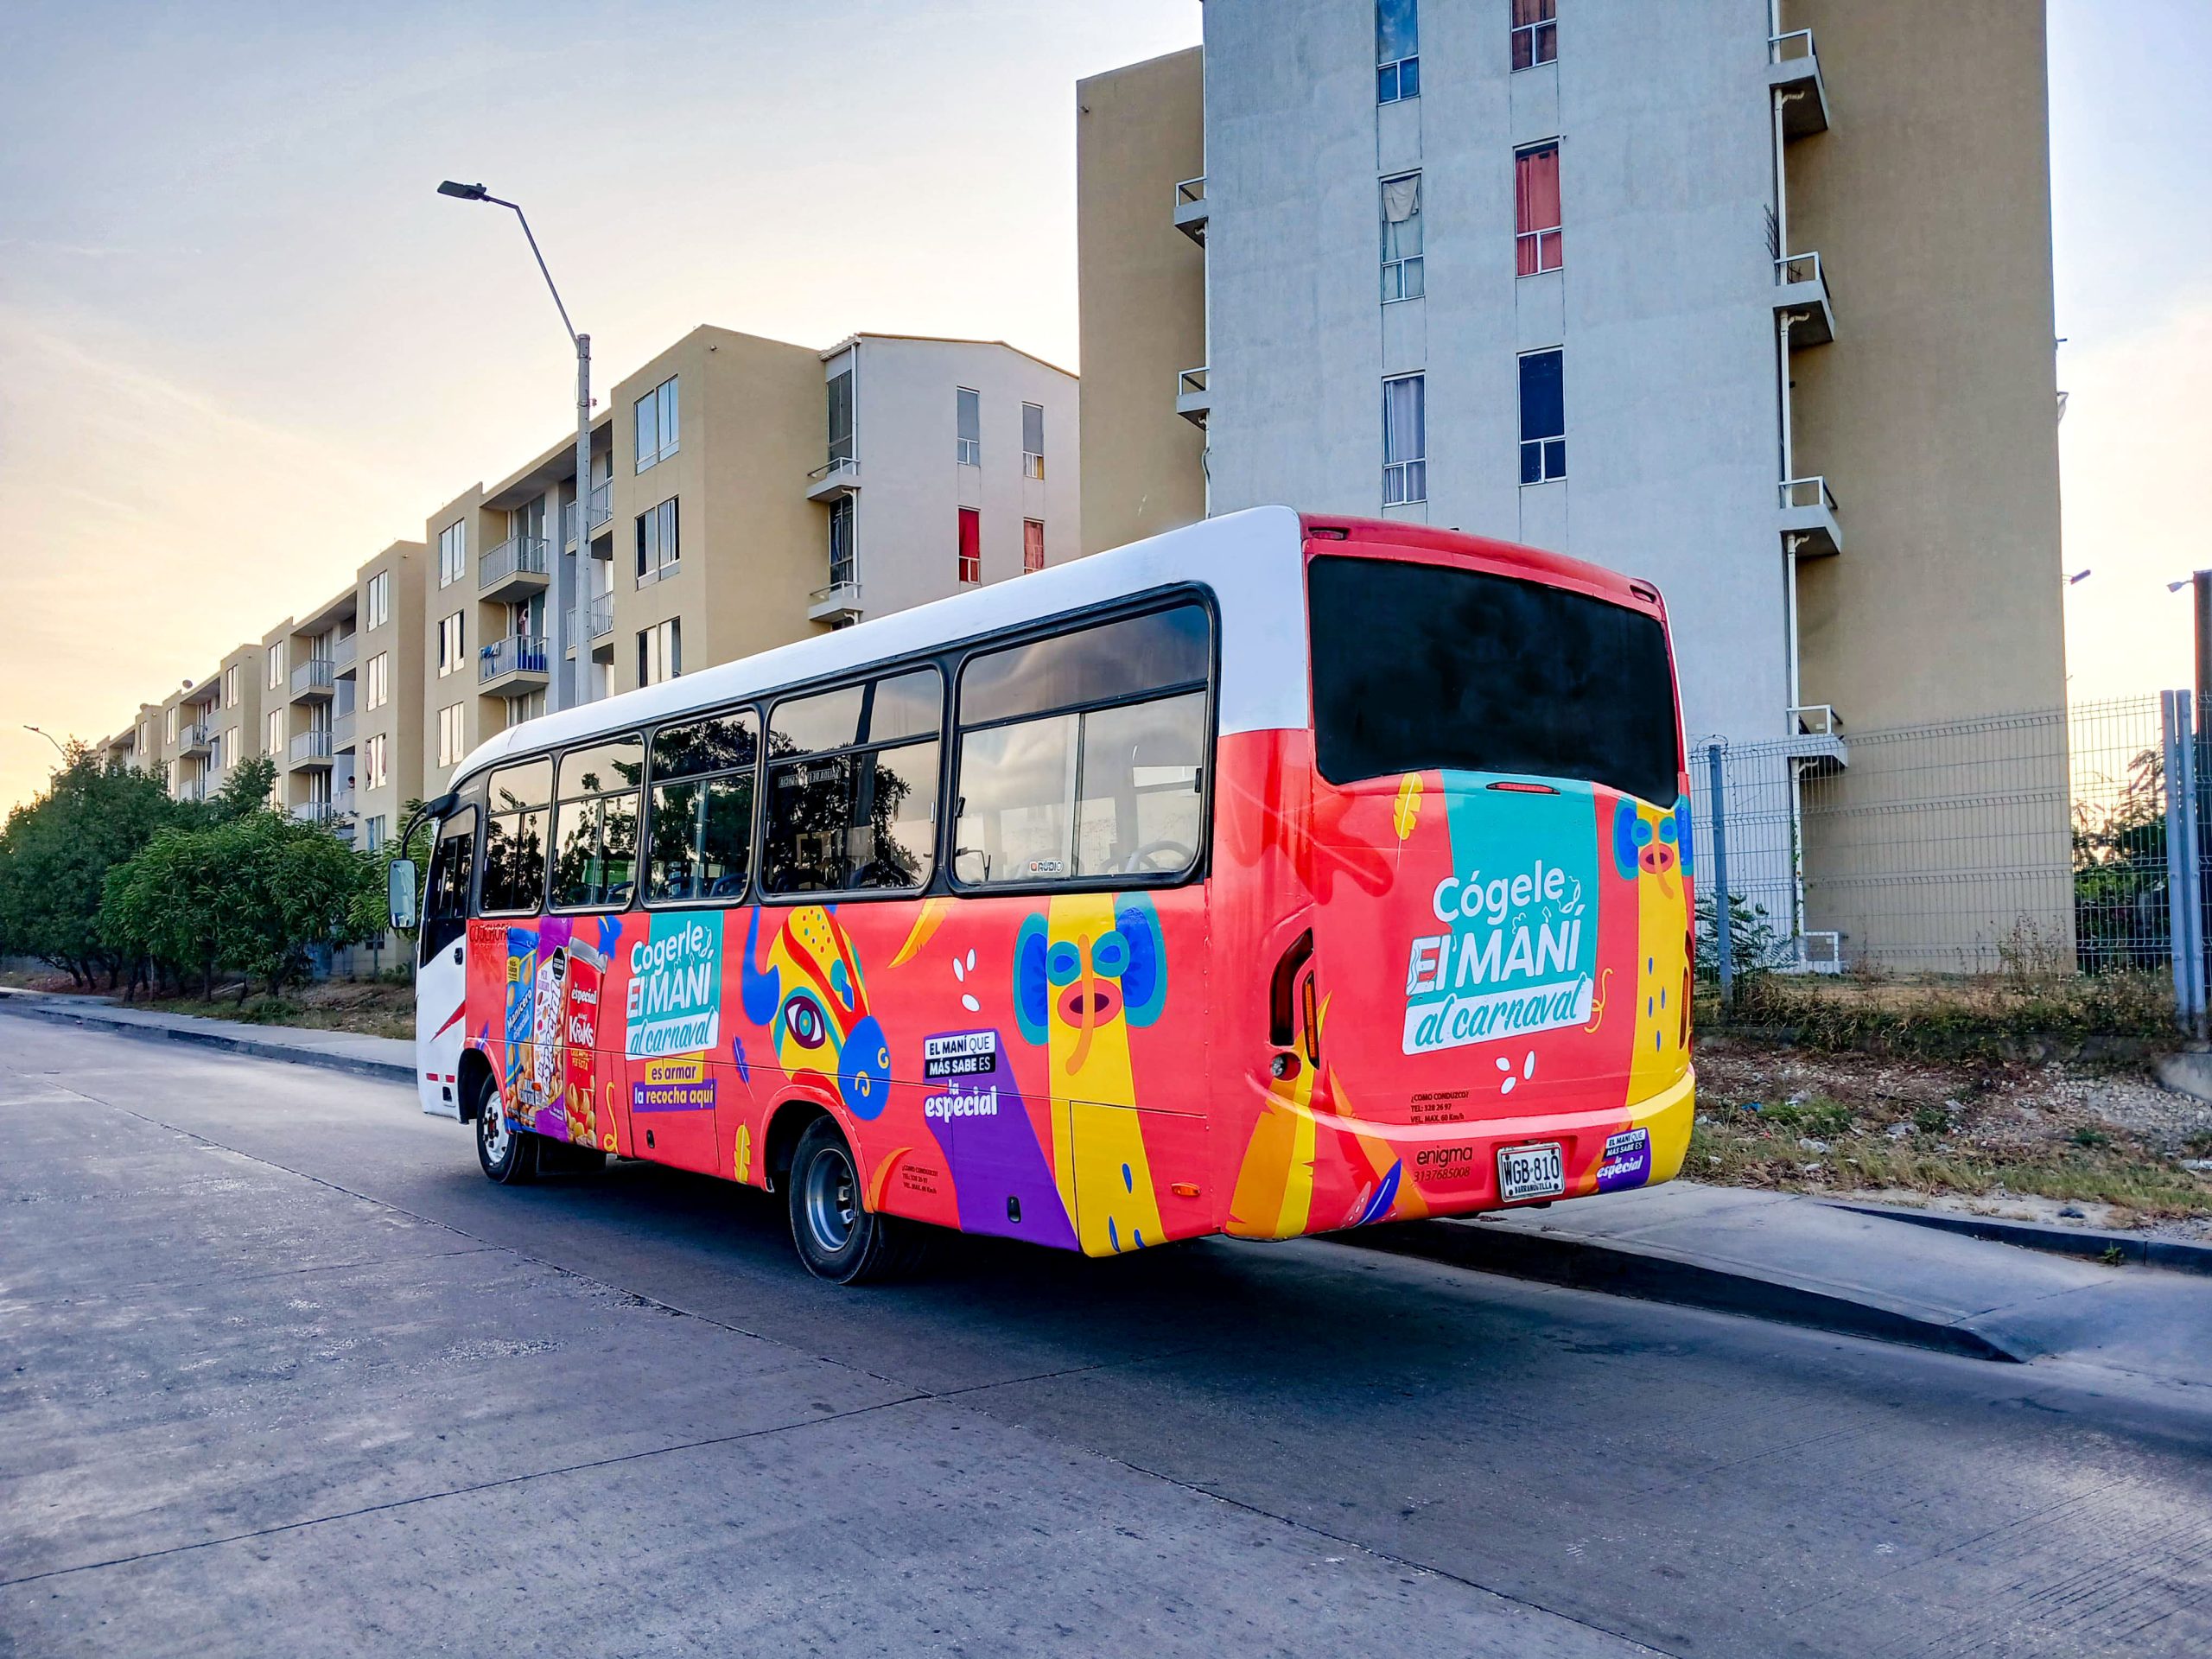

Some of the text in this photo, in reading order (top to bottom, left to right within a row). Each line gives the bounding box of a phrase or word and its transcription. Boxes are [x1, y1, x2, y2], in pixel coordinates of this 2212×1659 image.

[1433, 860, 1565, 925] Cógele
[631, 920, 703, 976] Cogerle
[1406, 904, 1586, 996] El MANÍ
[626, 949, 714, 1019] El MANÍ
[1415, 977, 1586, 1046] al carnaval
[630, 1007, 711, 1054] al carnaval
[929, 1035, 990, 1056] EL MANÍ QUE
[652, 1065, 696, 1080] es armar
[929, 1056, 990, 1076] MÁS SABE ES
[634, 1083, 714, 1109] la recocha aquí
[948, 1078, 959, 1096] la
[1433, 1090, 1469, 1101] CONDUZCO?
[925, 1085, 997, 1123] especial
[1631, 1131, 1643, 1141] QUE
[1635, 1141, 1643, 1150] ES
[1416, 1145, 1472, 1168] enigma
[1597, 1154, 1643, 1179] especial
